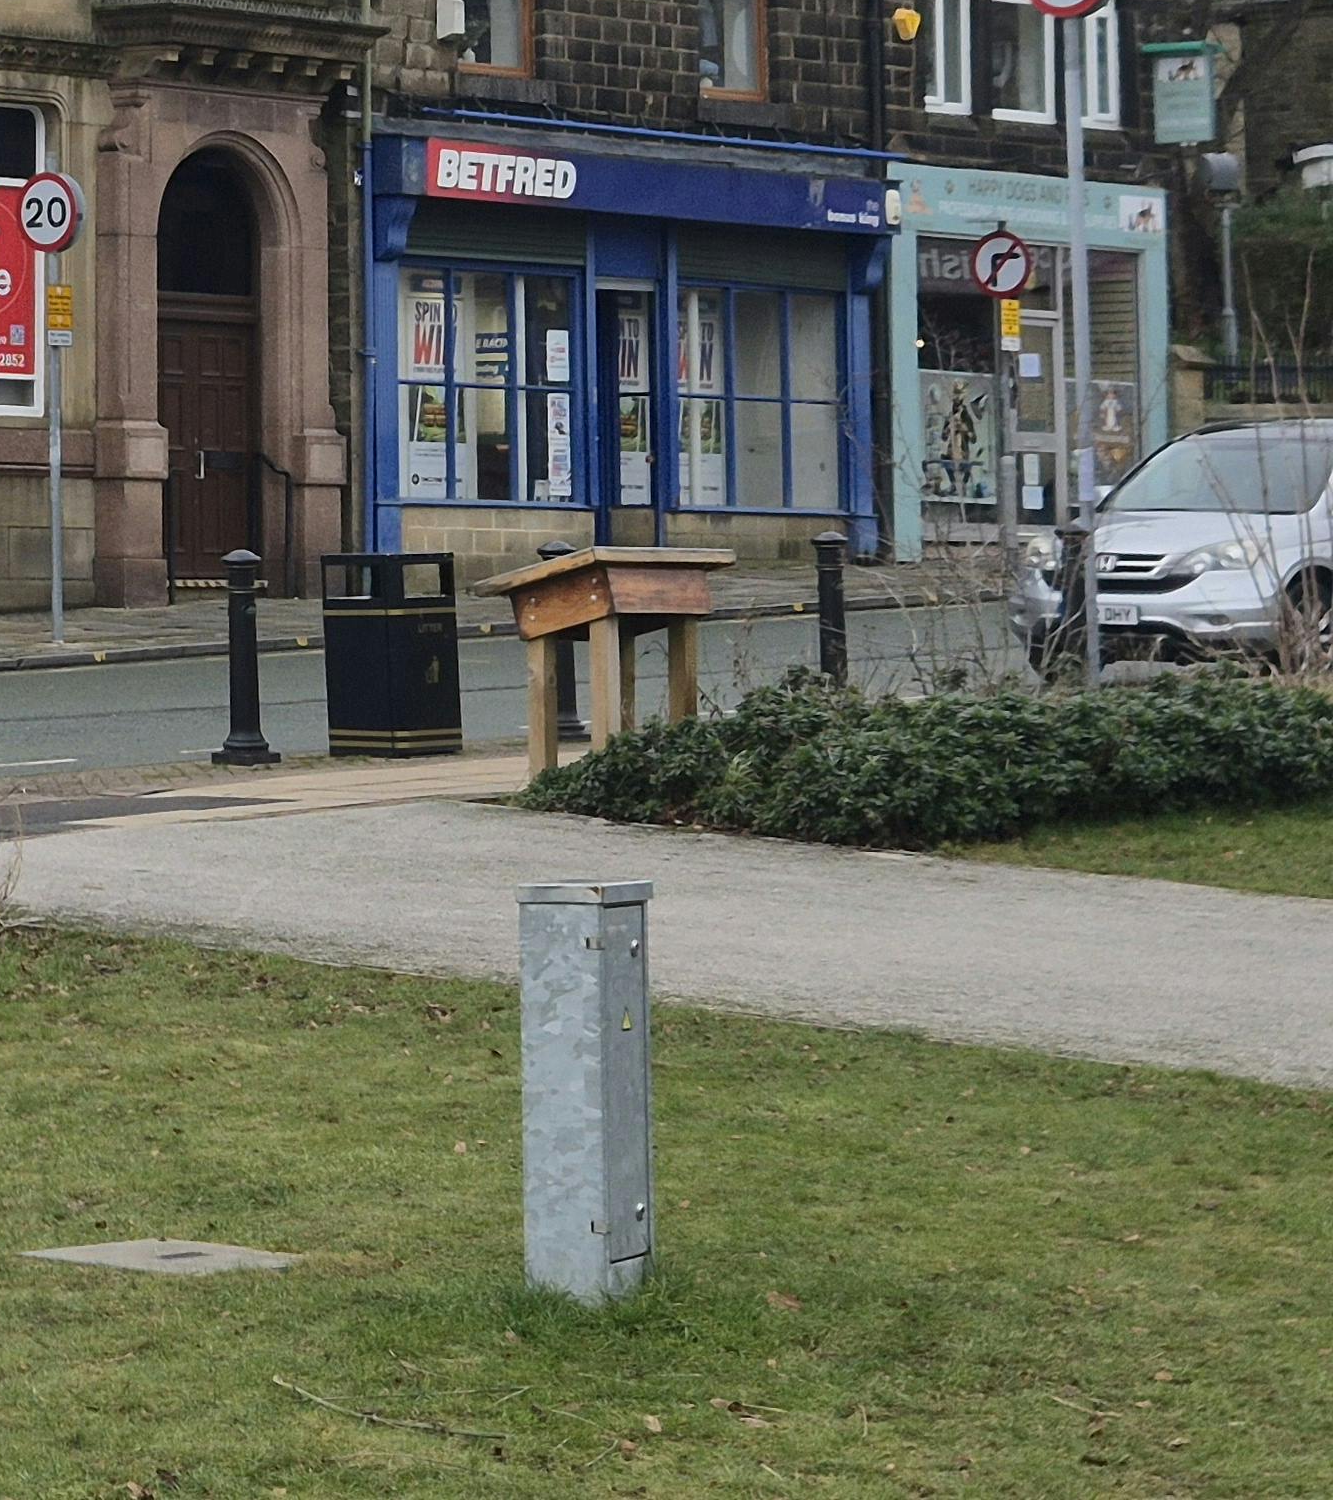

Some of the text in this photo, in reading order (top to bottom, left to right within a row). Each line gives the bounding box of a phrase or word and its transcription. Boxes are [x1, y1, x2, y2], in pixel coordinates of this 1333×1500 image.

[437, 148, 577, 199] BETFRED
[25, 197, 67, 229] 20
[415, 301, 441, 323] SPIN
